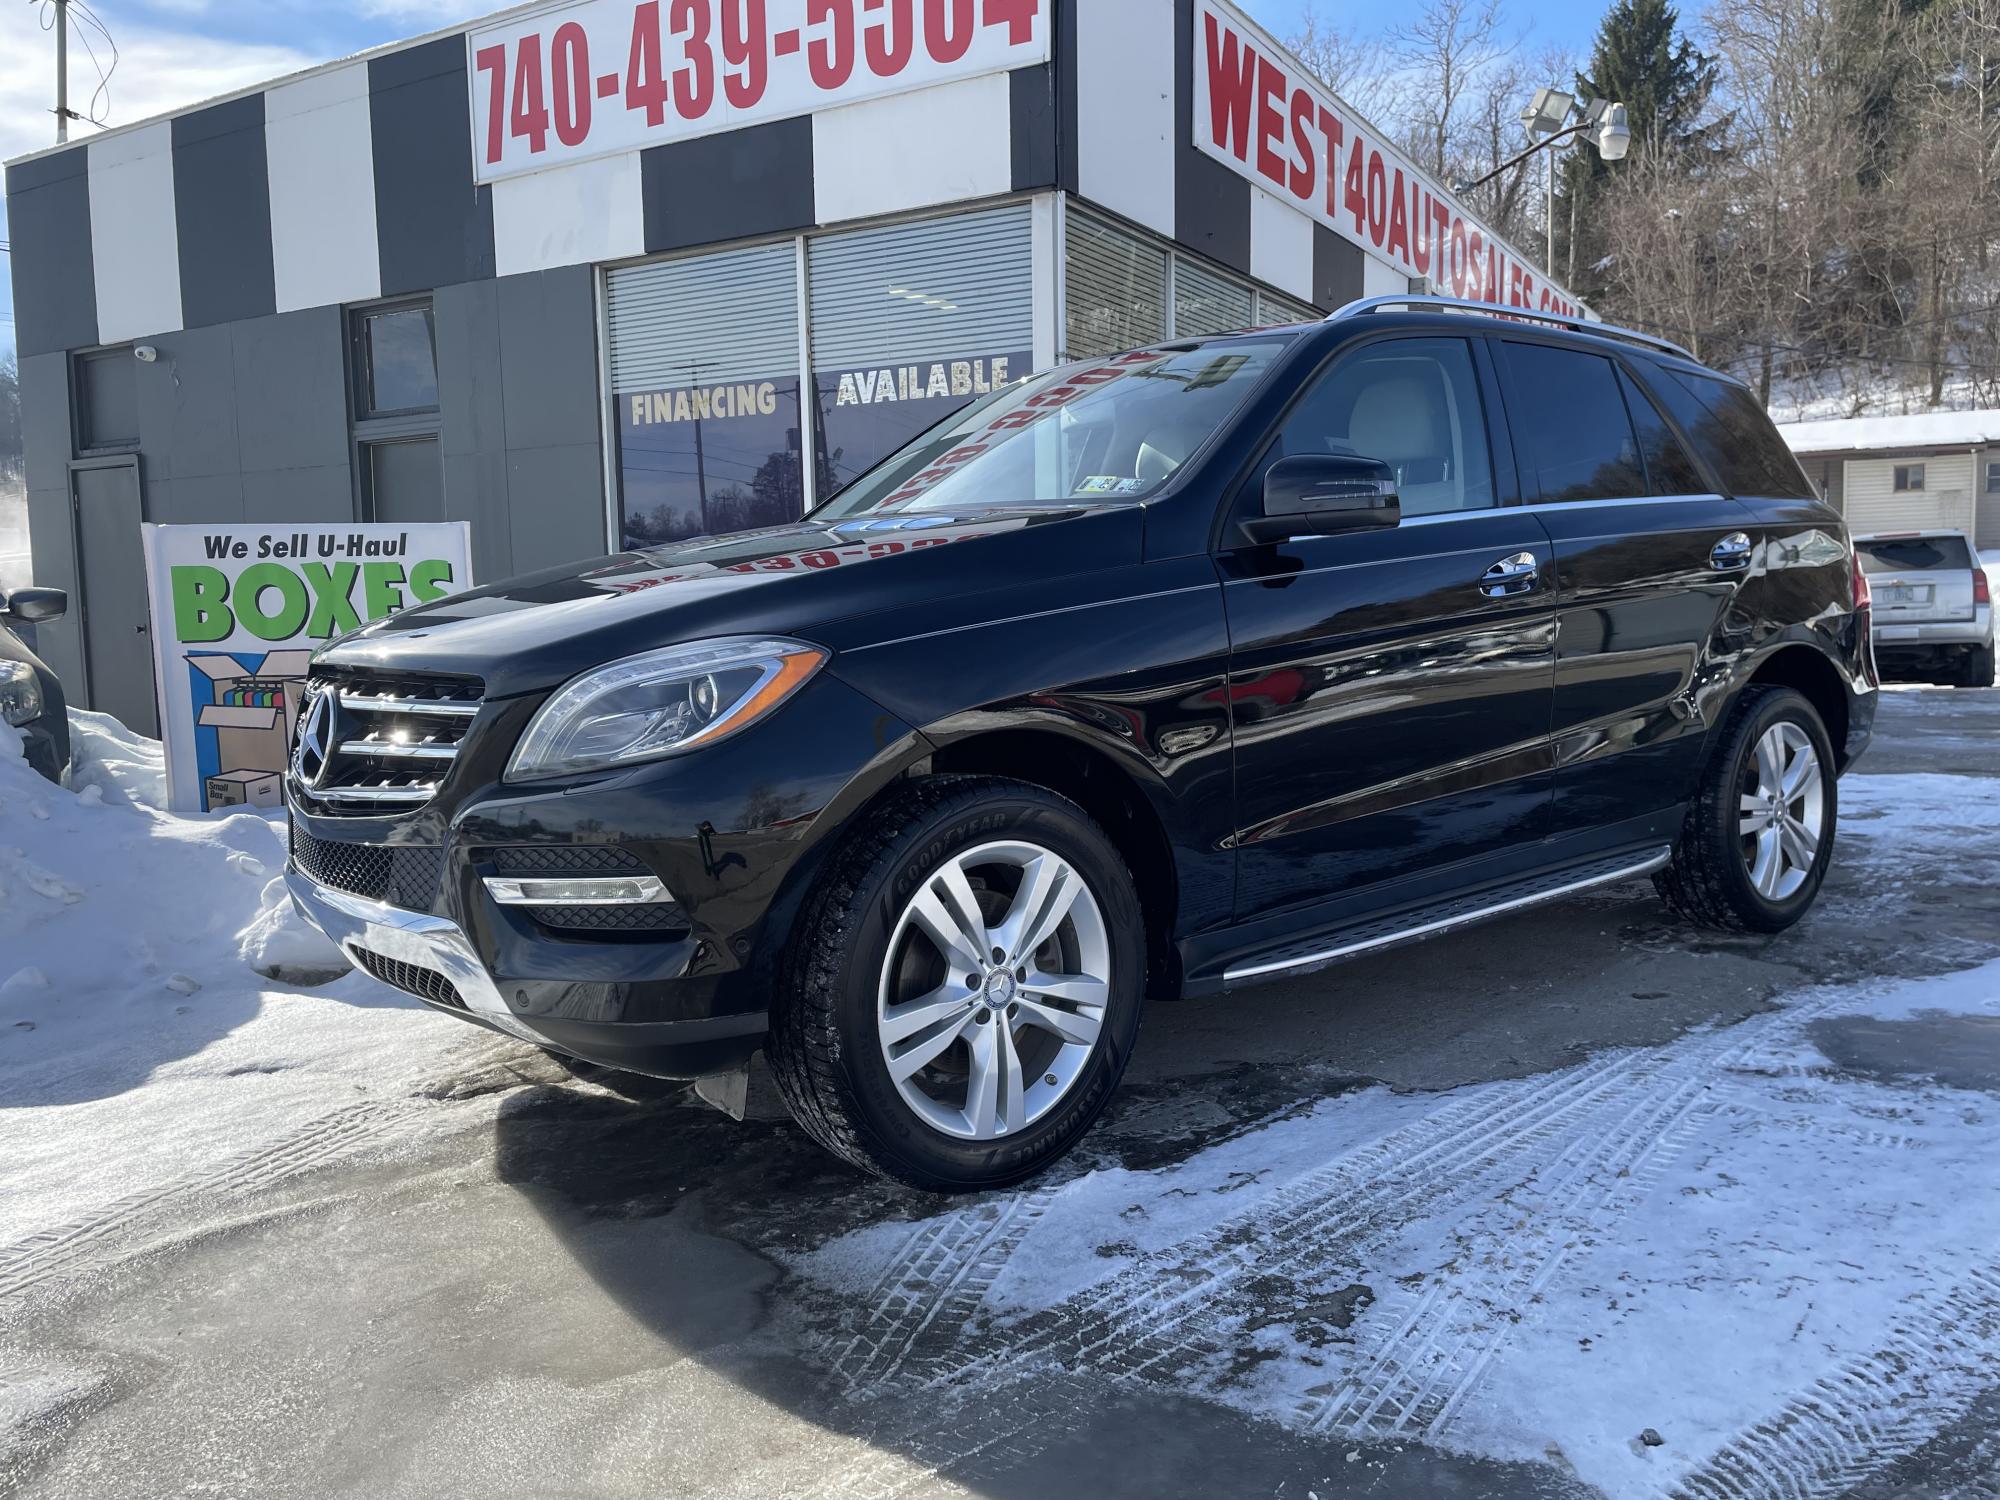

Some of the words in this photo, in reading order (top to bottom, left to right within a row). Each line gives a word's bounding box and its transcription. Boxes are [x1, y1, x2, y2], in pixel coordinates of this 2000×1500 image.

[1203, 11, 1574, 330] WEST40AUTOSALESCOM
[836, 356, 1009, 407] AVAILABLE
[630, 382, 776, 426] FINANCING
[204, 536, 248, 559] We
[257, 534, 308, 558] Sell
[317, 532, 408, 557] U-Haul
[208, 781, 229, 792] Small
[209, 790, 224, 800] Box
